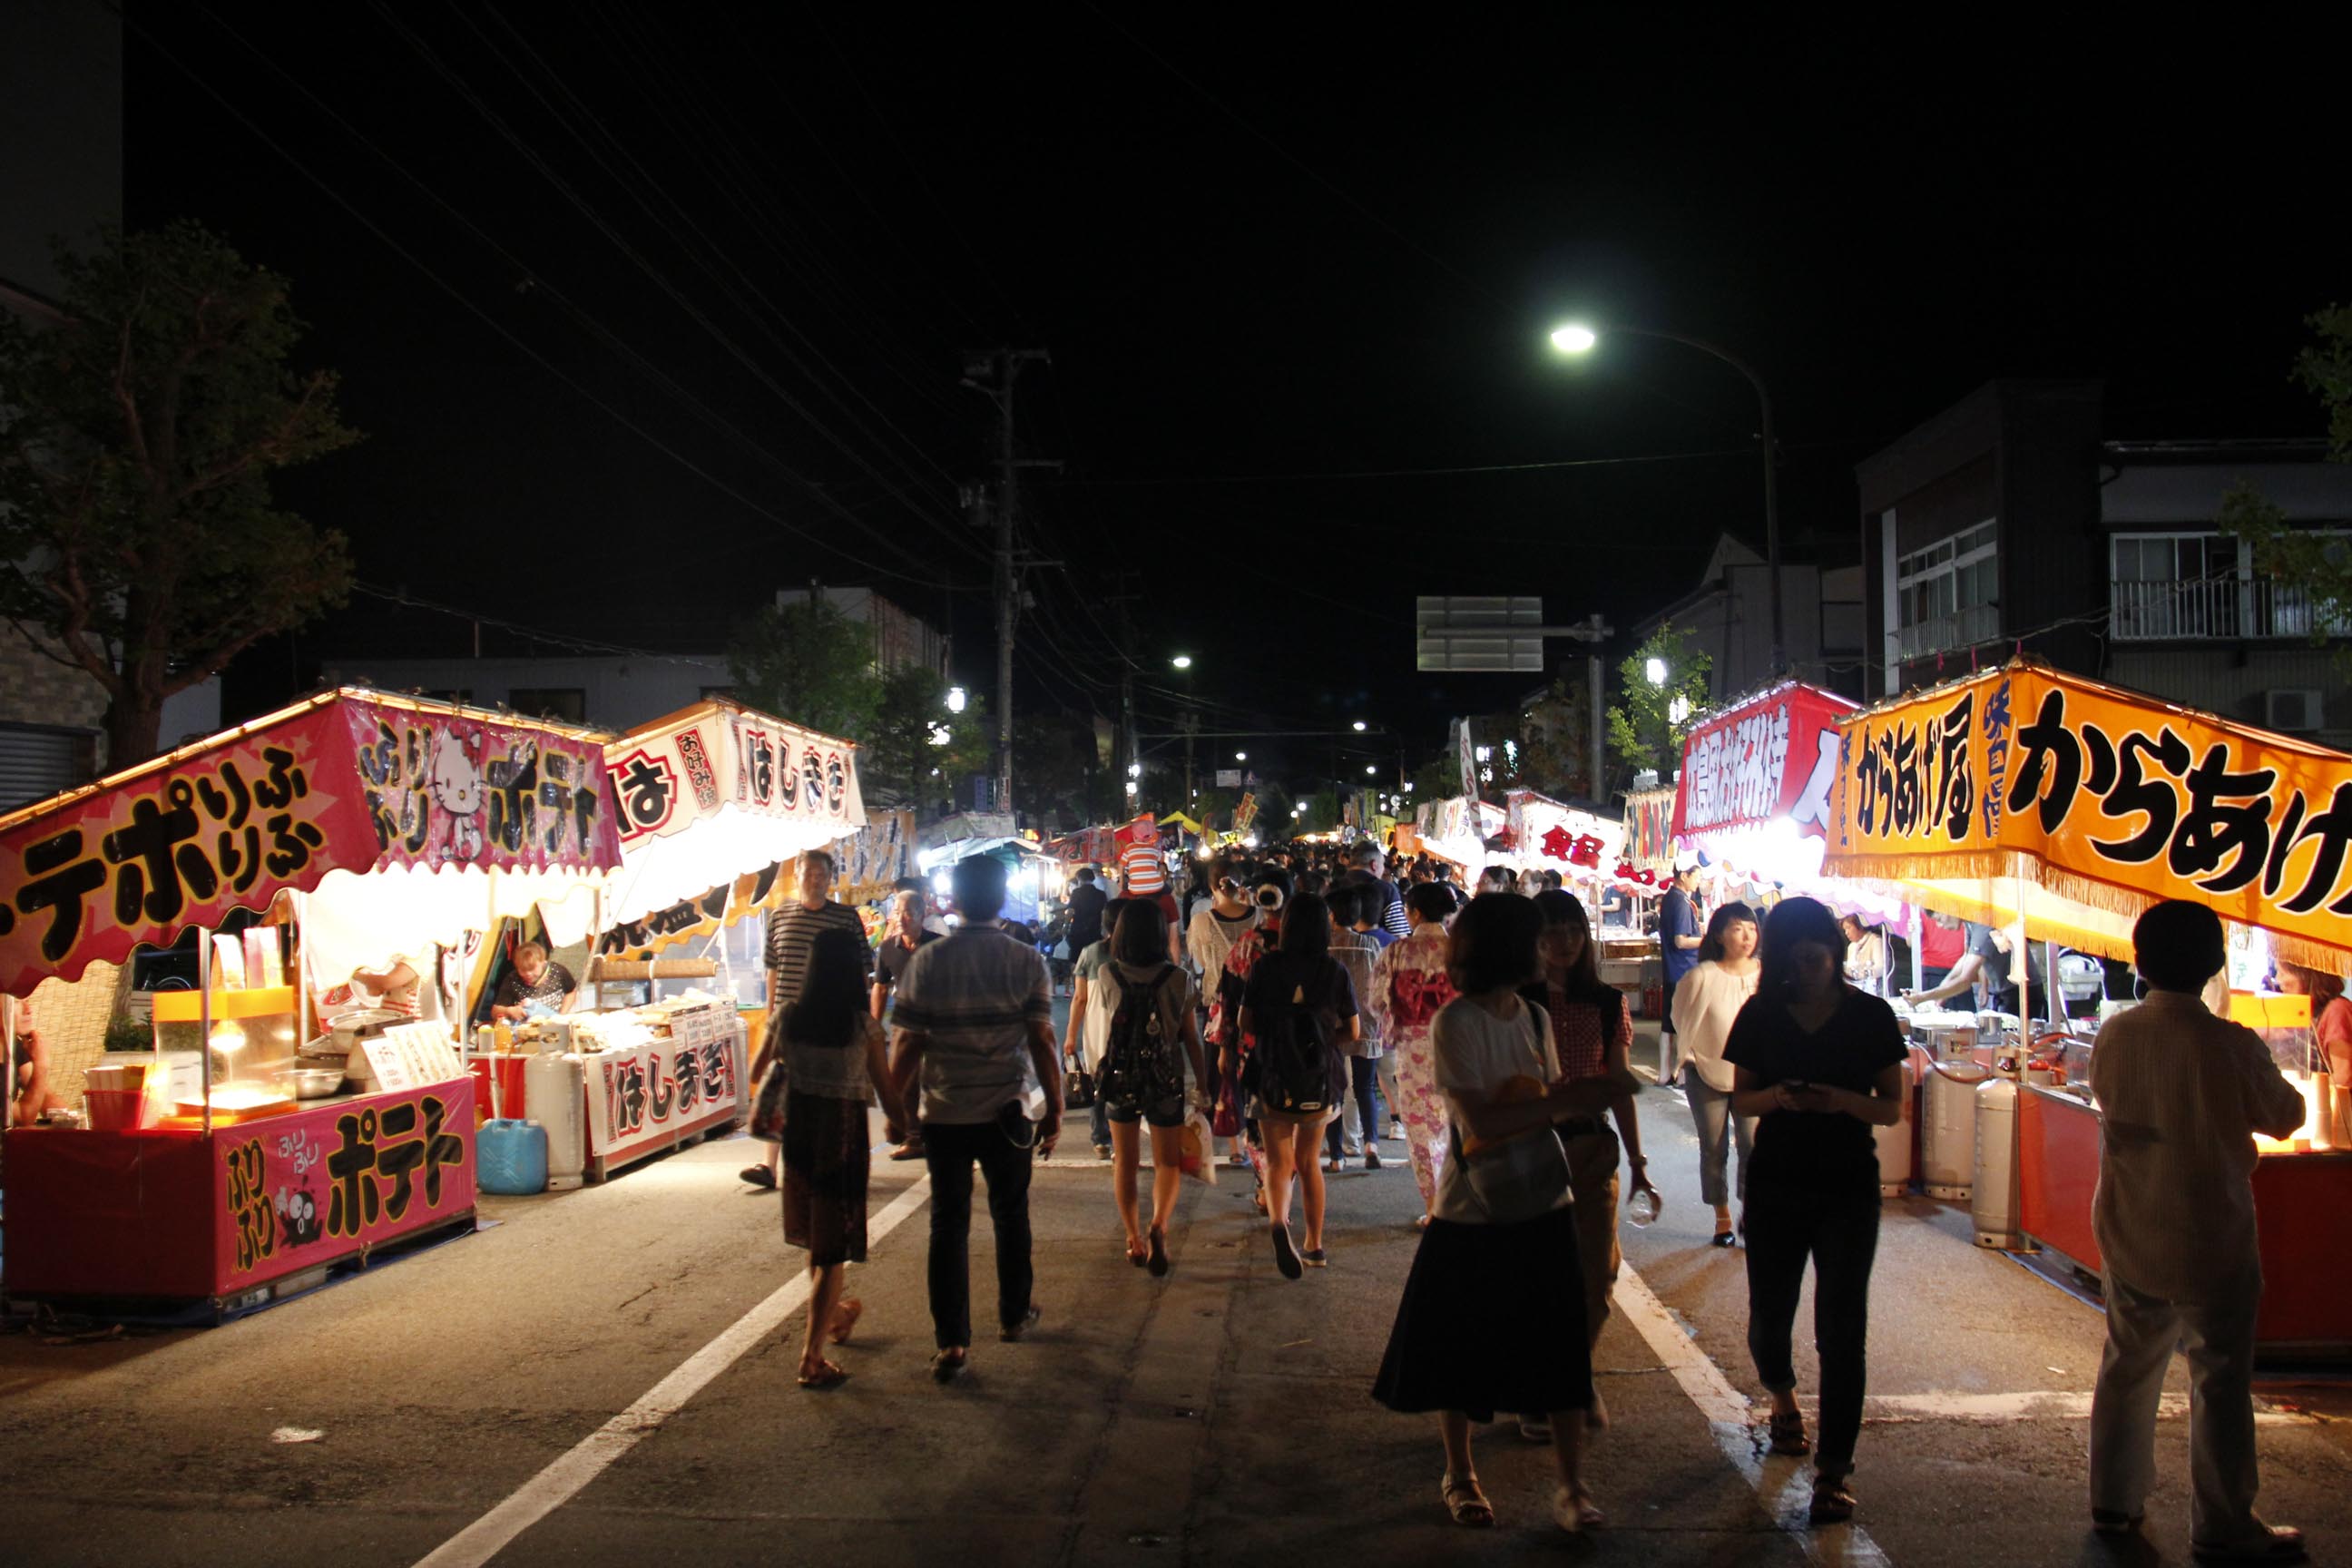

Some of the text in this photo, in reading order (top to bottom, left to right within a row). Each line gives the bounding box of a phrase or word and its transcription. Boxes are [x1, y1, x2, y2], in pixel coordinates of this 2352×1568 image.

[486, 739, 598, 857] ポテト
[679, 734, 720, 805] お好み焼
[746, 728, 846, 817] はしまき
[1684, 703, 1789, 831] 広島風お好み焼
[1857, 691, 1975, 841] からあげ屋
[614, 1044, 727, 1139] はしまき
[325, 1093, 464, 1239] ポテト
